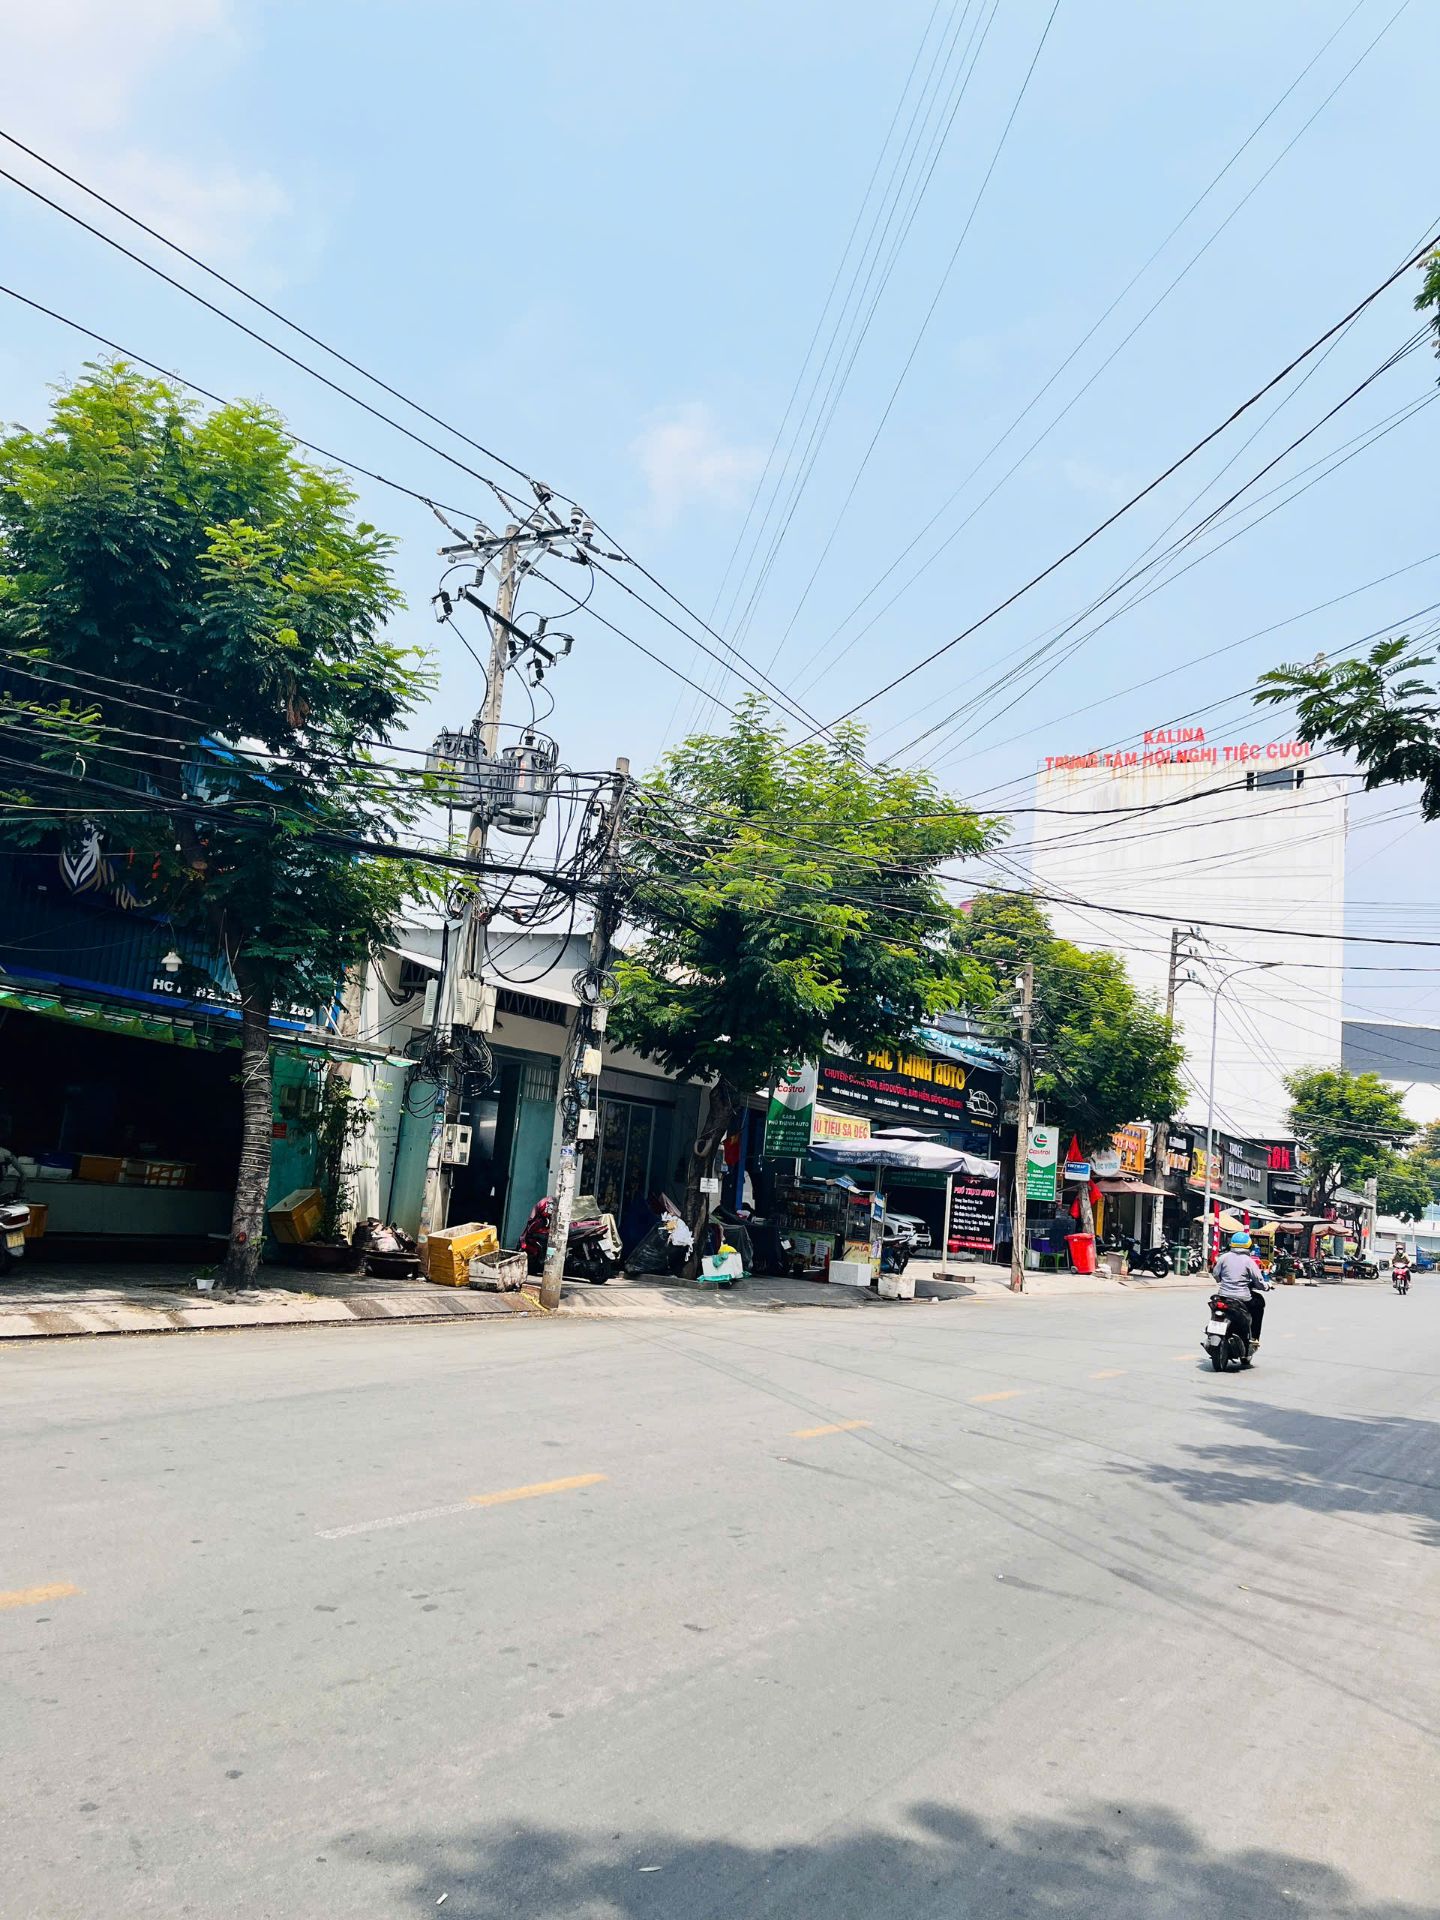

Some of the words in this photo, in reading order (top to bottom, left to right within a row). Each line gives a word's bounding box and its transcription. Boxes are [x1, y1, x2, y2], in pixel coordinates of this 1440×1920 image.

[1144, 727, 1205, 744] KALINA
[1045, 754, 1098, 769] TRUNG
[1104, 750, 1138, 768] TÂM
[1143, 747, 1171, 768] HỘI
[1176, 747, 1217, 765] NGHỊ
[1223, 742, 1261, 764] TIỆC
[934, 1062, 965, 1090] AUTO
[778, 1085, 805, 1093] Castrol
[1229, 1142, 1243, 1160] THREE
[981, 1189, 996, 1198] AUTO
